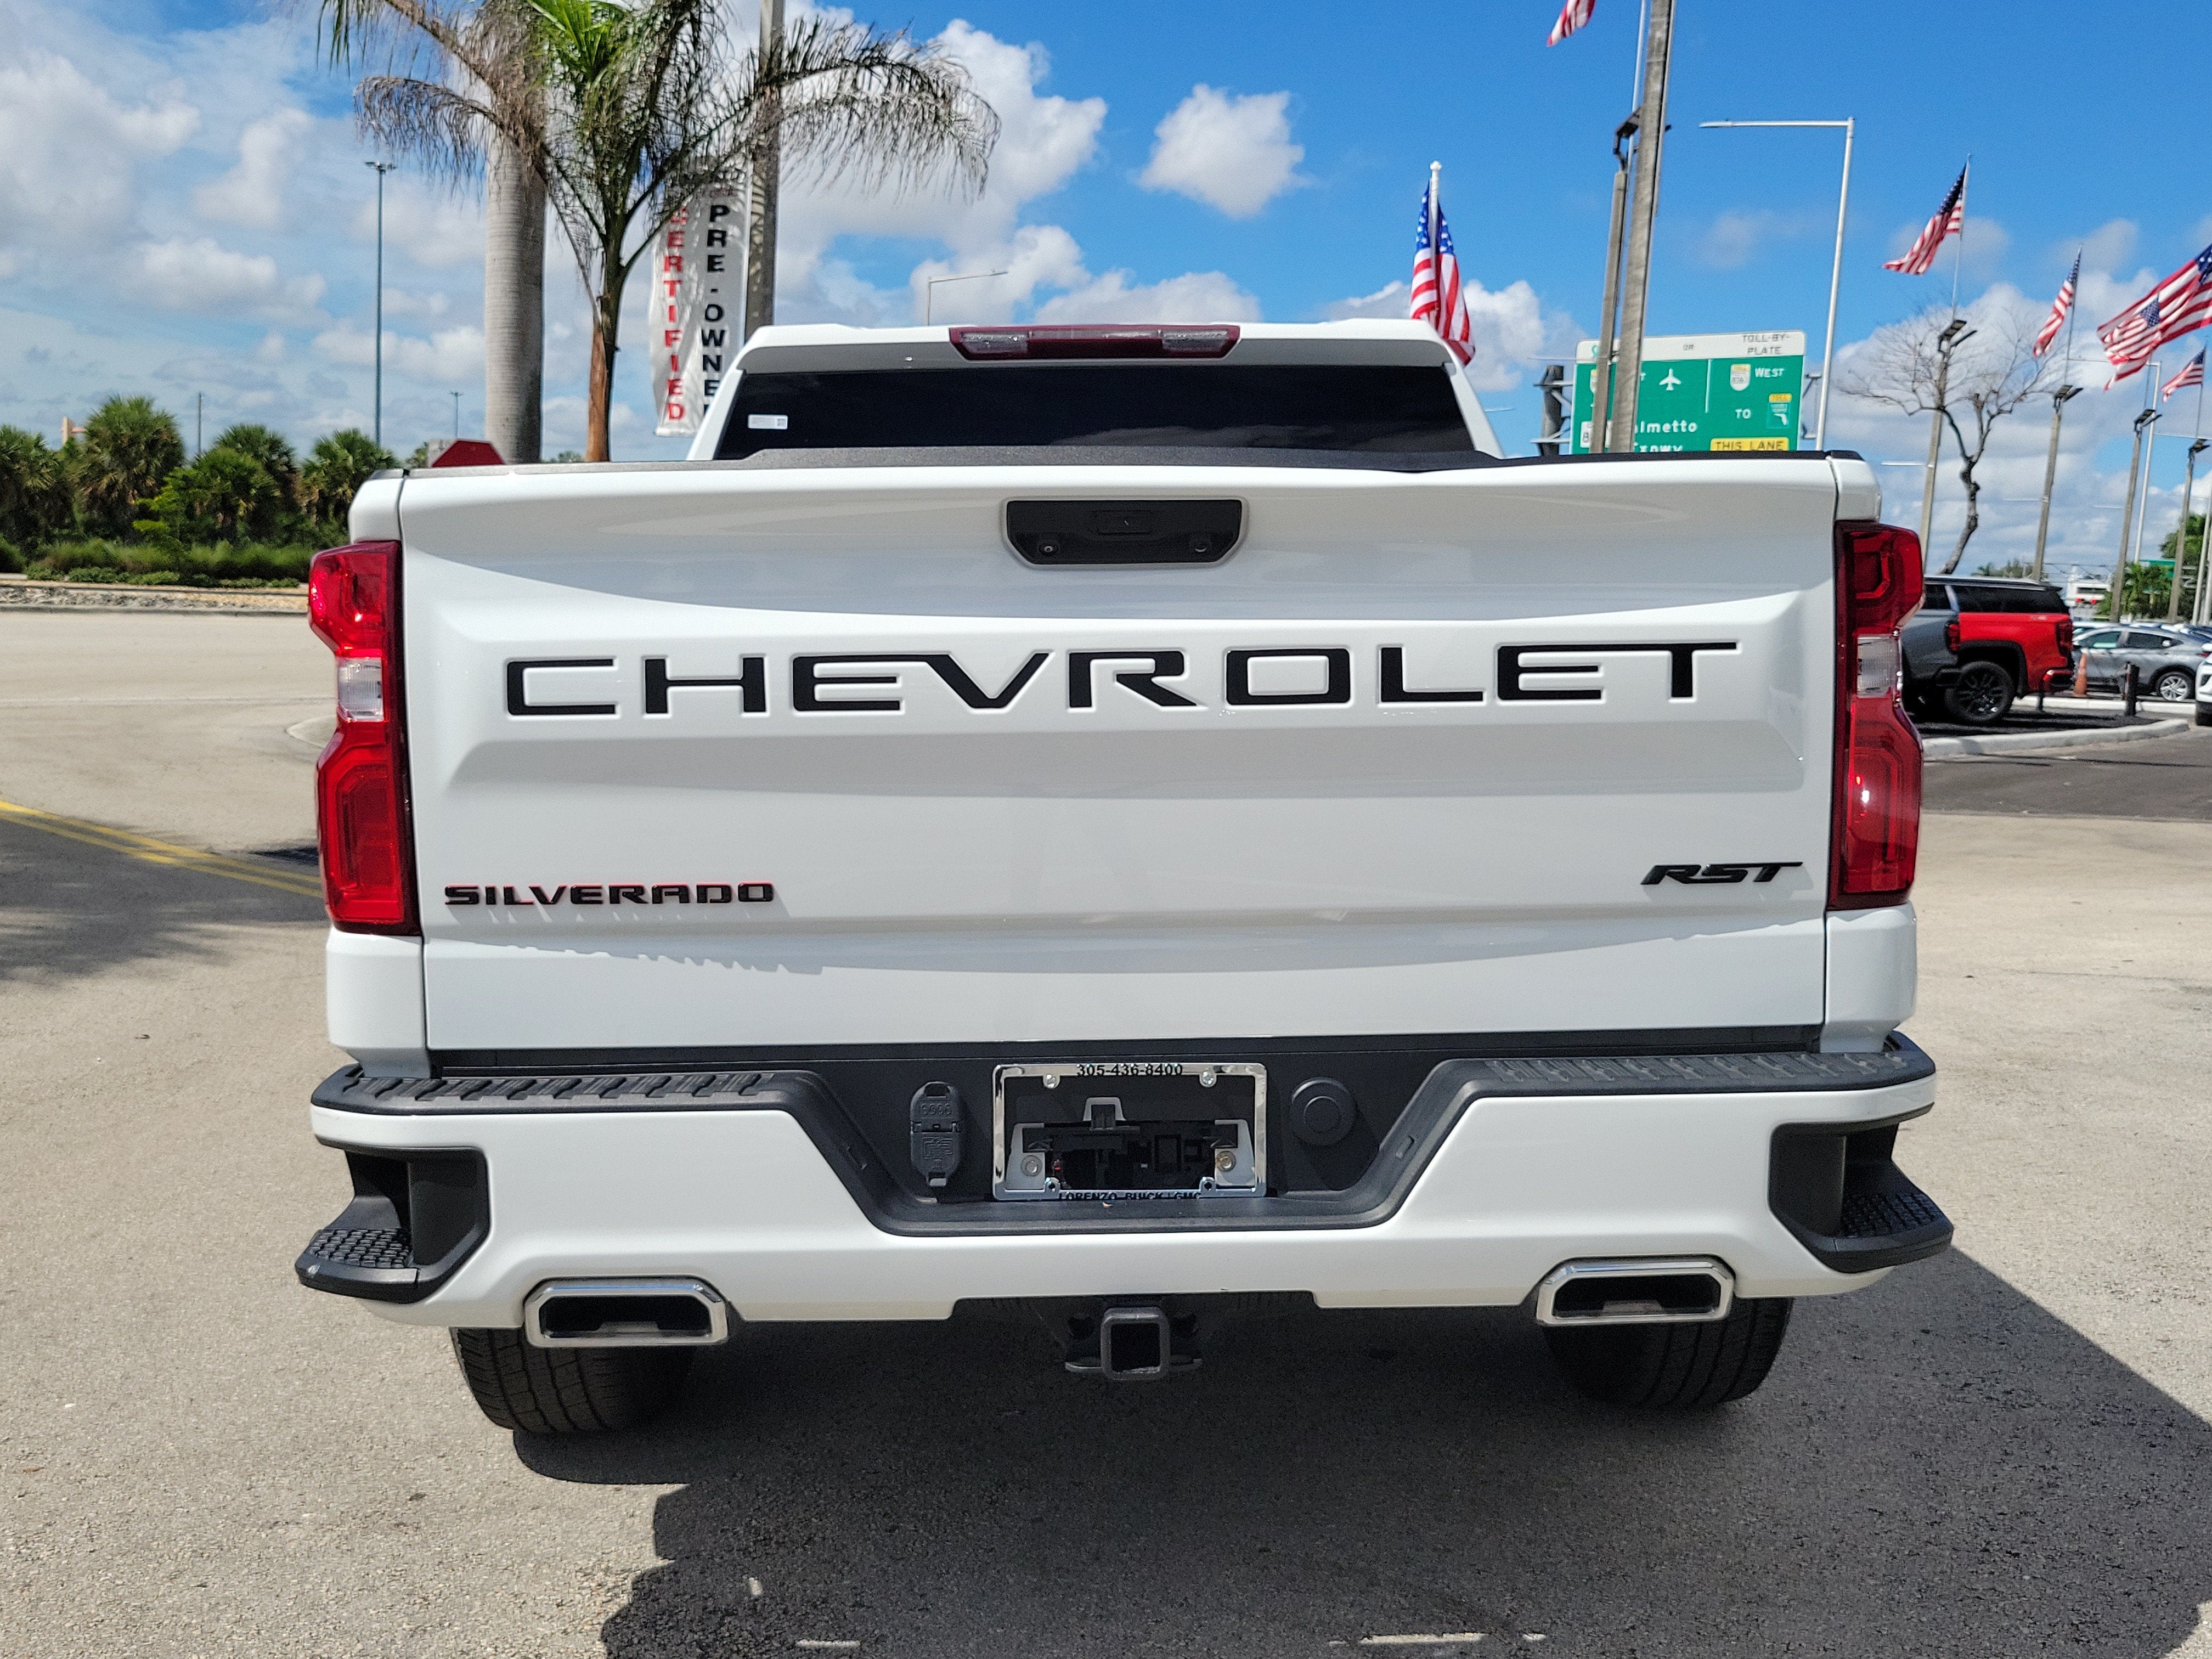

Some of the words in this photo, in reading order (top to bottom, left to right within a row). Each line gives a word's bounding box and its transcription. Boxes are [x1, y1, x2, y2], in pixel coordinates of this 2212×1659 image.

[701, 204, 731, 415] PRE-OWNE
[1747, 347, 1782, 356] PLATE
[1754, 368, 1785, 378] WEST
[1735, 408, 1752, 419] TO
[1714, 441, 1742, 450] THIS
[1750, 440, 1785, 450] LANE
[507, 643, 1737, 716] CHEVROLET
[1640, 861, 1803, 885] RST
[445, 882, 775, 905] SILVERADO
[1076, 1063, 1183, 1076] 305-436-8400
[1059, 1191, 1118, 1200] LORENZO
[1125, 1192, 1164, 1200] BUICK
[1174, 1191, 1201, 1200] GMC
